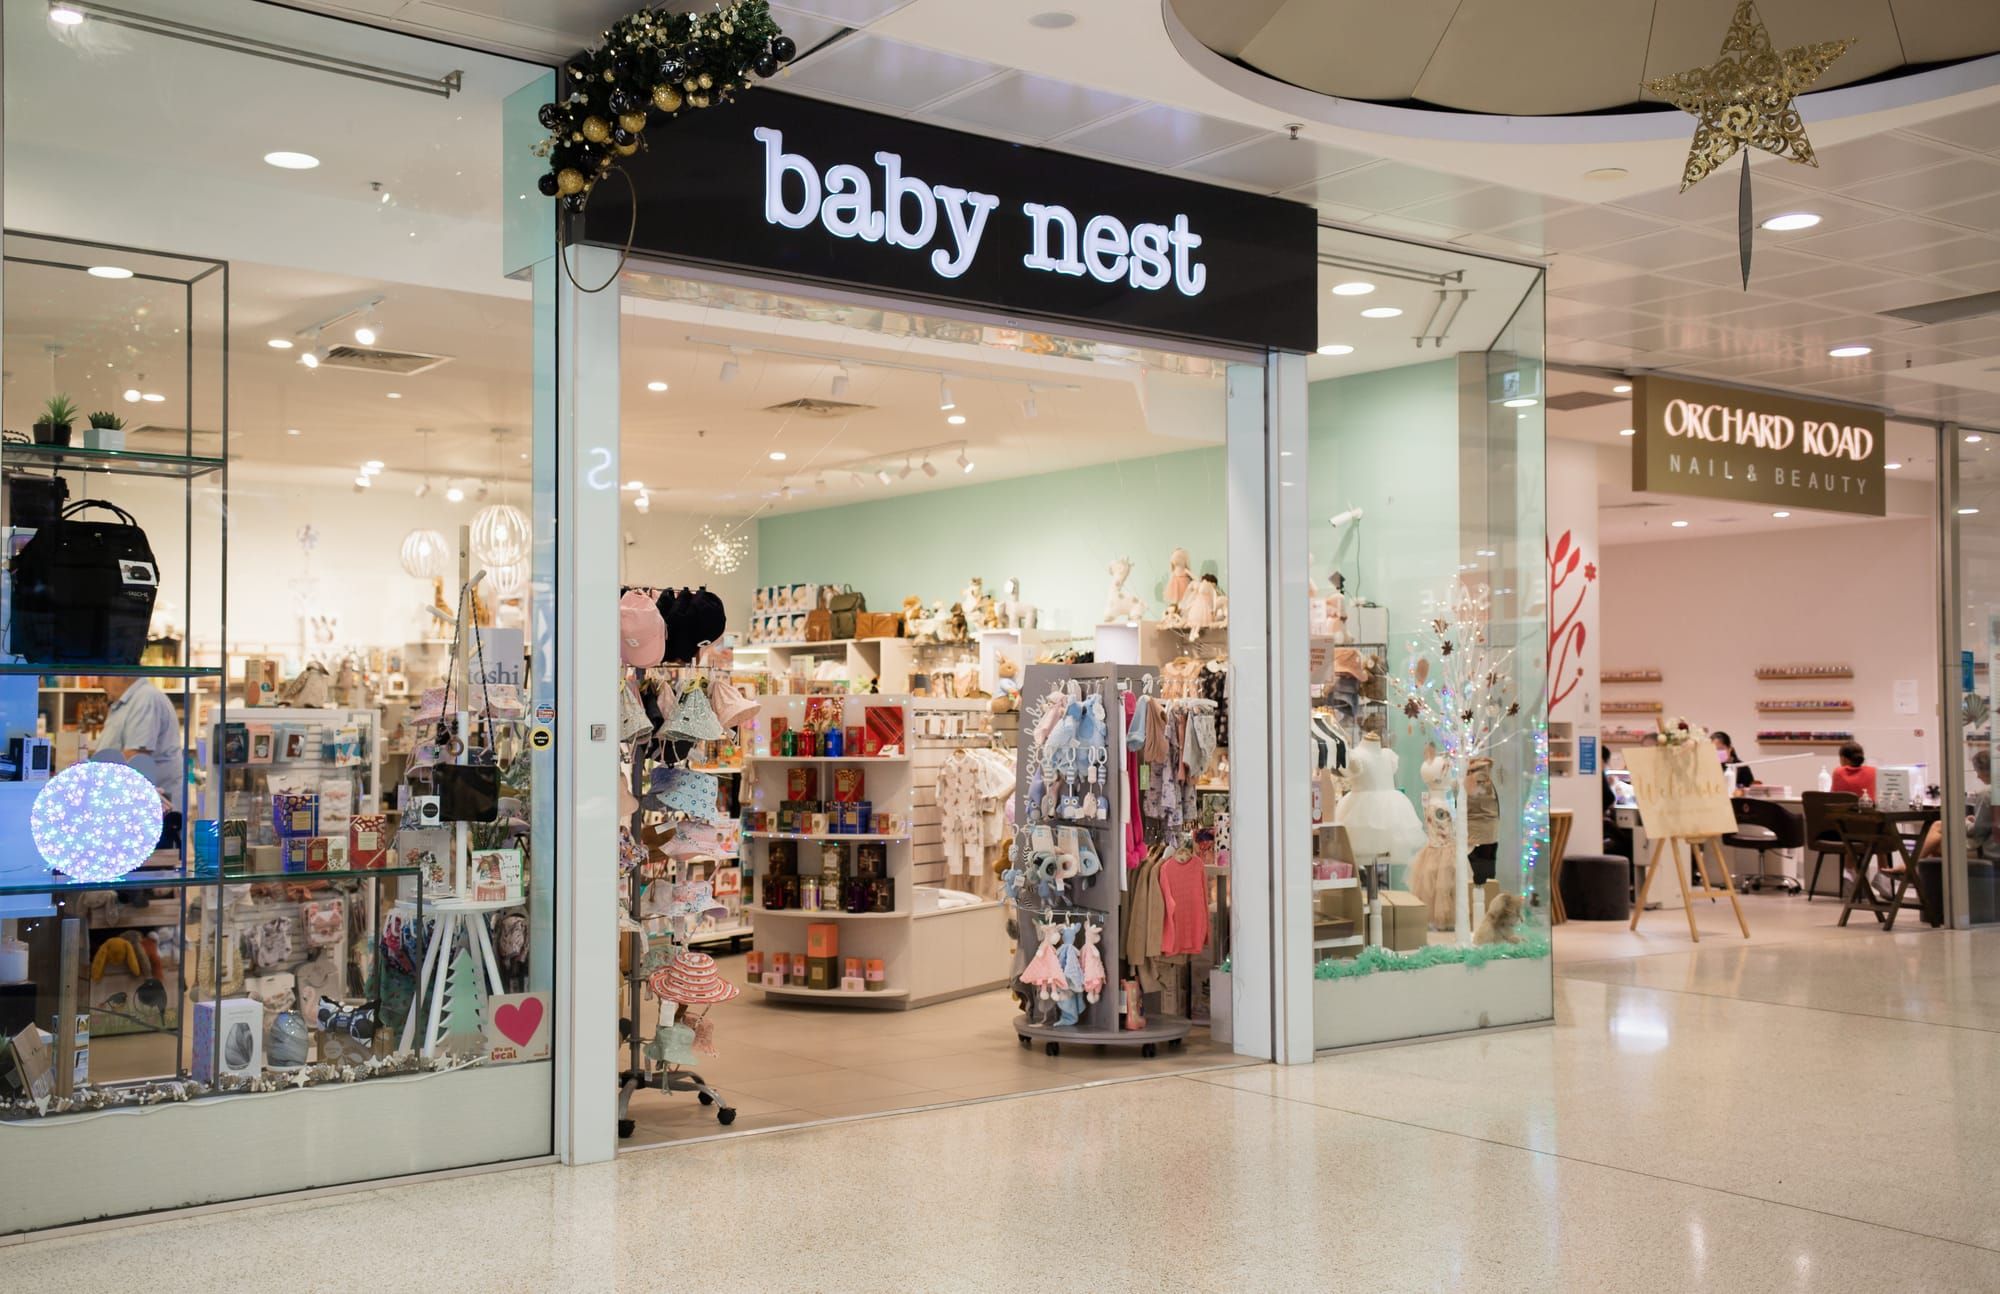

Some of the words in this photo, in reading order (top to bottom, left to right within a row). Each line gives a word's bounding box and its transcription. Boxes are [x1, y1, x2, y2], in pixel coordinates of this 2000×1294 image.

[754, 126, 1000, 277] baby
[1023, 203, 1207, 296] nest
[1664, 399, 1794, 450] ORCHARD
[1803, 421, 1874, 461] ROAD
[1670, 454, 1733, 479] NAIL
[1747, 464, 1758, 481] &
[1775, 468, 1867, 494] BEAUTY
